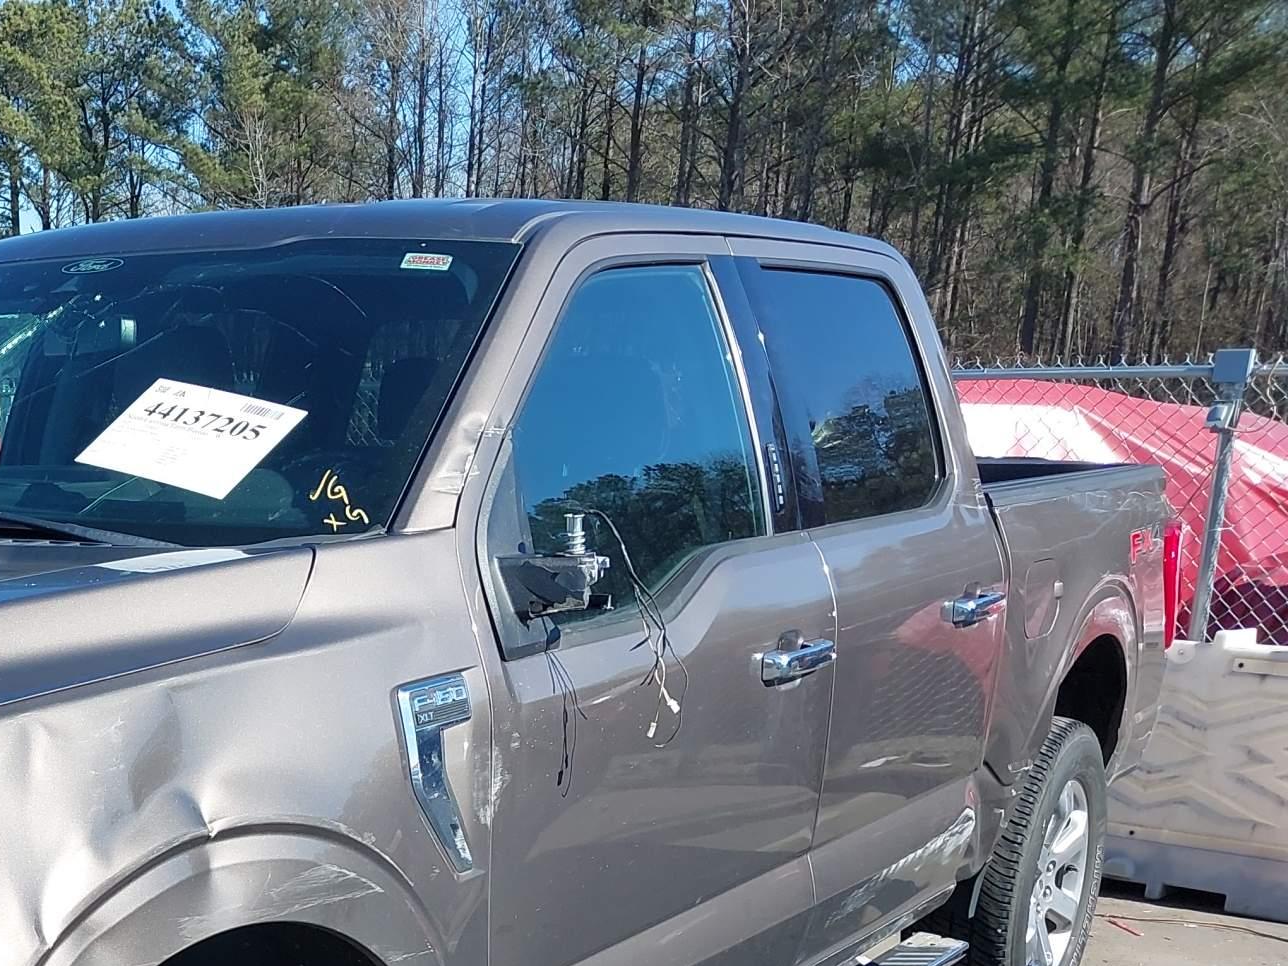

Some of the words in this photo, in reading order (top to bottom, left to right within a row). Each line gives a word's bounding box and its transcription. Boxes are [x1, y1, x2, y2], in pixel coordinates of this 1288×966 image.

[143, 402, 267, 441] 44137205
[1129, 521, 1163, 567] FX4
[414, 686, 468, 711] F-150
[417, 711, 435, 724] XLT
